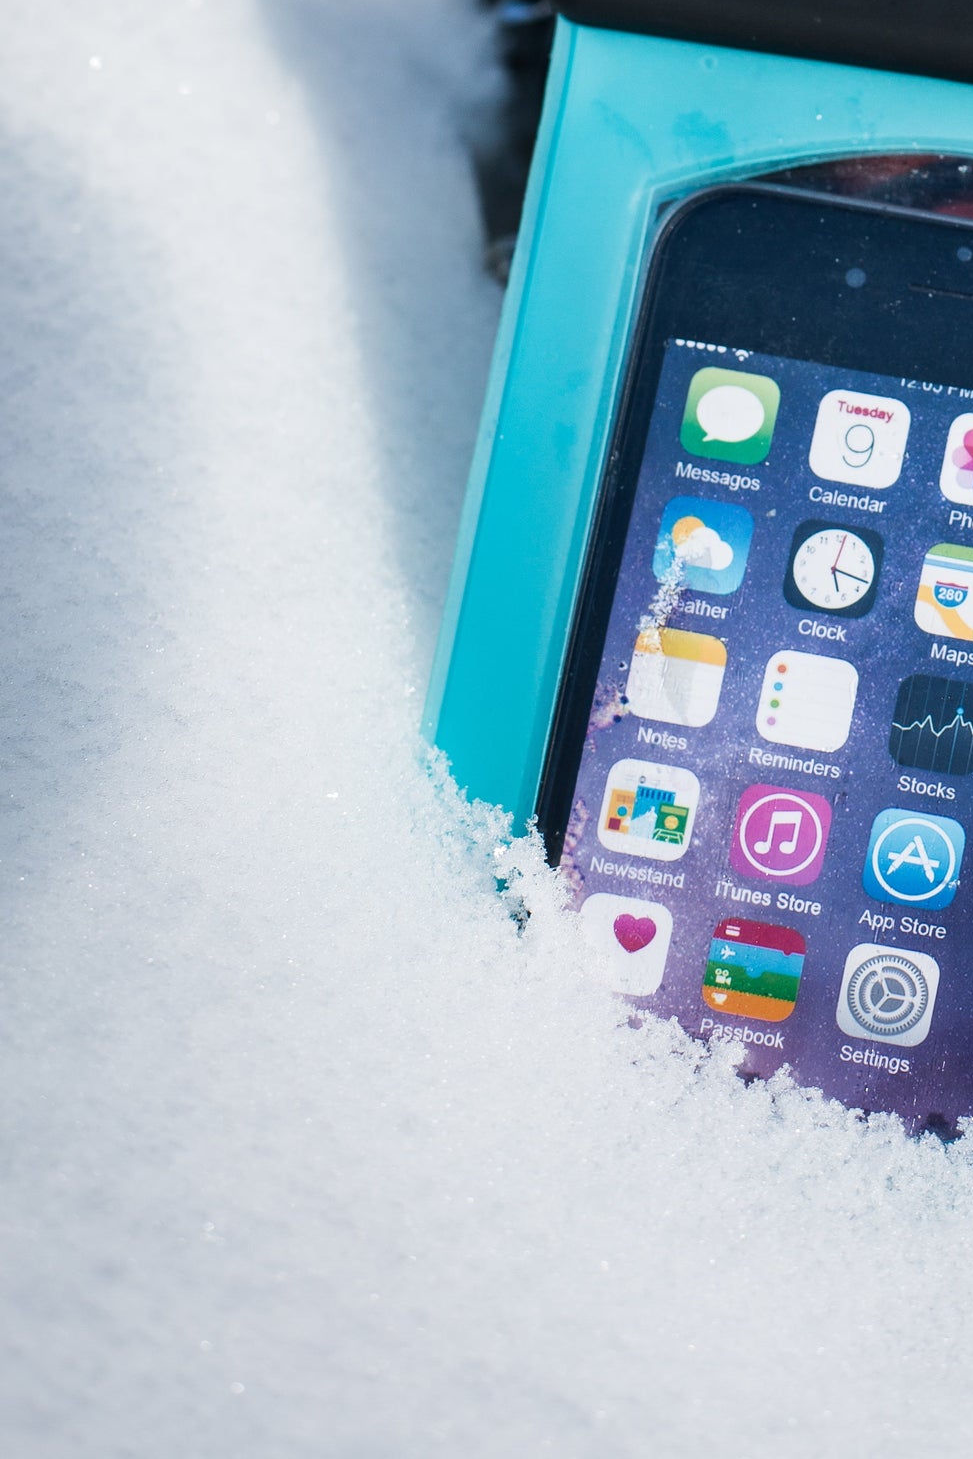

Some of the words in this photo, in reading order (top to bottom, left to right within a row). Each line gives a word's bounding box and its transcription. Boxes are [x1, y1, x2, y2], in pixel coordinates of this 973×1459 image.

[837, 400, 895, 424] Tuesday
[842, 423, 875, 468] 9
[808, 485, 887, 514] Calendar
[937, 587, 964, 602] 280
[797, 618, 847, 642] Clock
[637, 726, 688, 750] Notes
[748, 747, 841, 779] Reminders
[898, 775, 956, 800] Stocks
[589, 856, 685, 889] Newsstand
[715, 880, 771, 908] iTunes
[776, 891, 822, 916] Store
[858, 909, 894, 933] App
[900, 916, 947, 940] Store
[700, 1017, 785, 1049] Passbook
[839, 1044, 911, 1075] Settings
